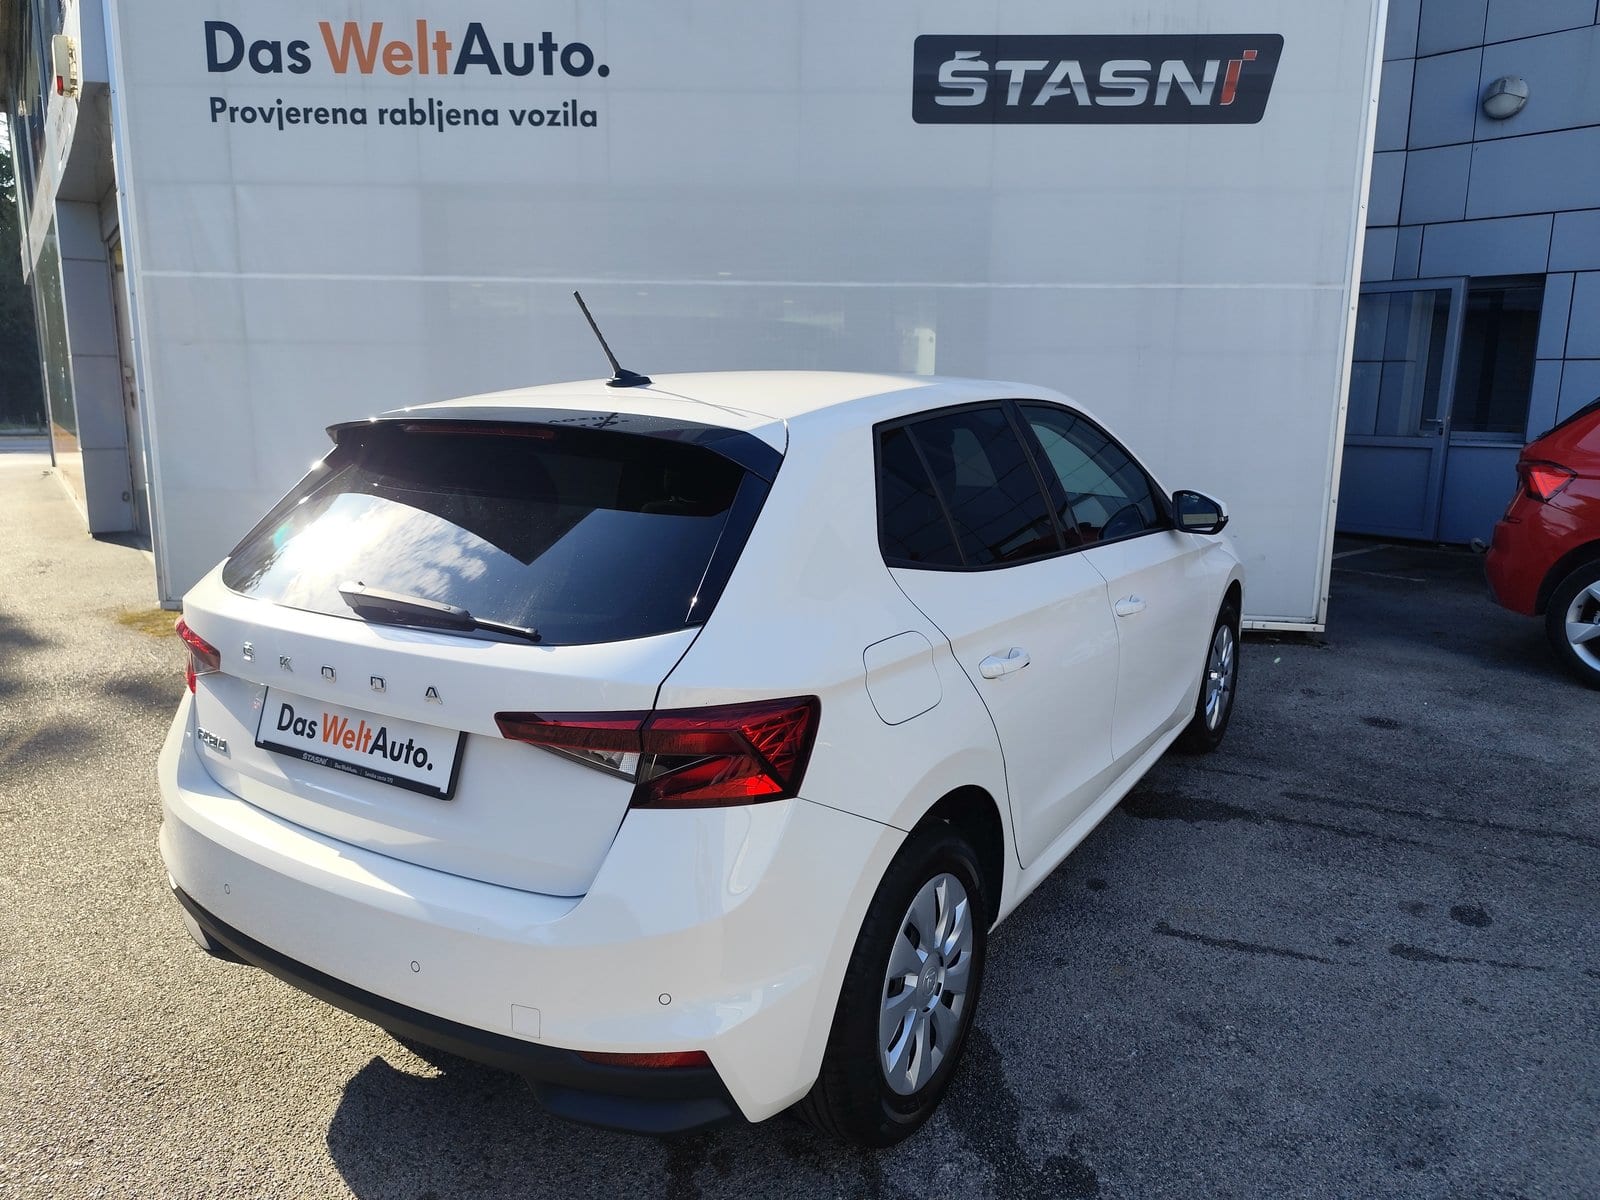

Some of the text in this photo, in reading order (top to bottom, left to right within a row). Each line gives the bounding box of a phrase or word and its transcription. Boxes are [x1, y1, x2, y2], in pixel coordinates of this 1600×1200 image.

[204, 19, 610, 77] Das WeltAuto.
[209, 96, 598, 132] Provjerena rabljena vozila
[277, 703, 433, 771] Das WeltAuto.
